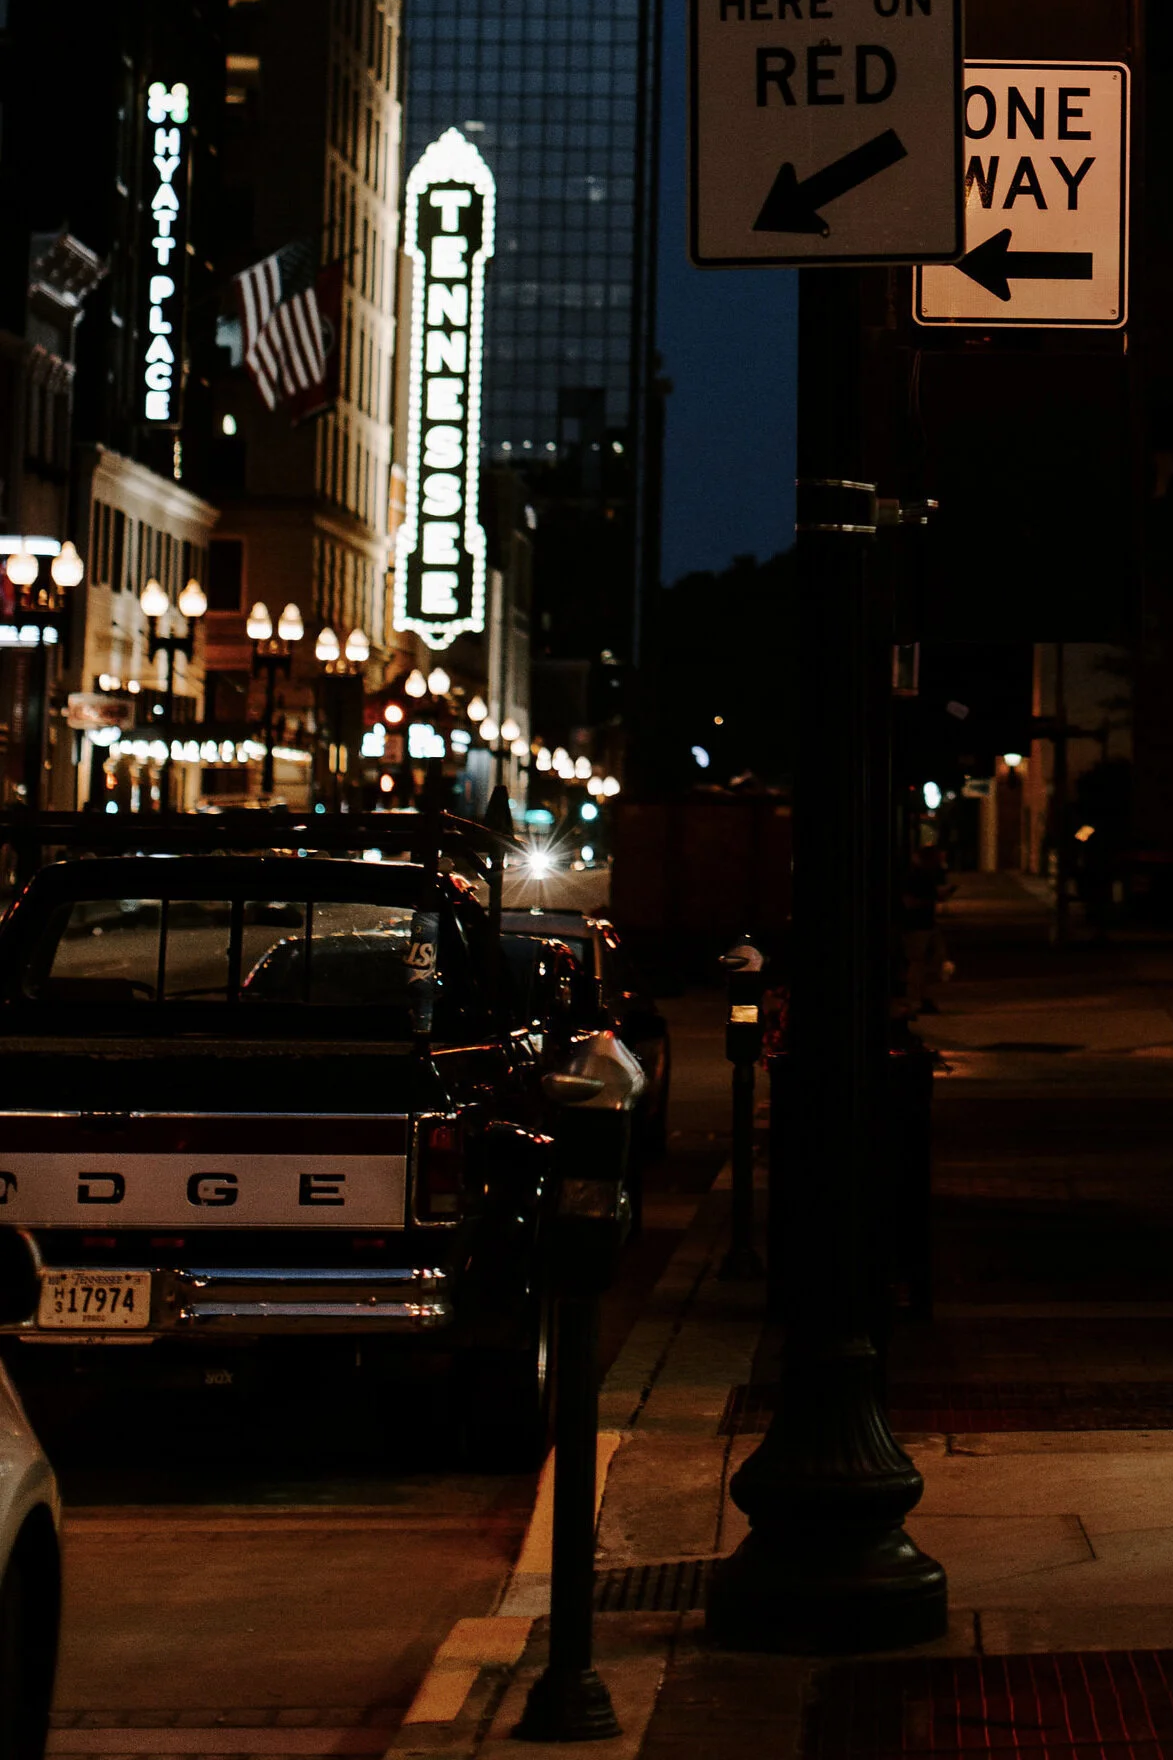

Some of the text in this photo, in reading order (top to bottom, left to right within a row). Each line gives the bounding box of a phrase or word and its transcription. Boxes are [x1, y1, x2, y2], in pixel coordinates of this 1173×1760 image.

[755, 44, 896, 107] RED
[964, 85, 1091, 141] ONE
[964, 156, 1096, 210] WAY
[145, 128, 181, 421] HYATT PLACE
[421, 188, 472, 616] TENNESSEE
[67, 1287, 135, 1314] 17974
